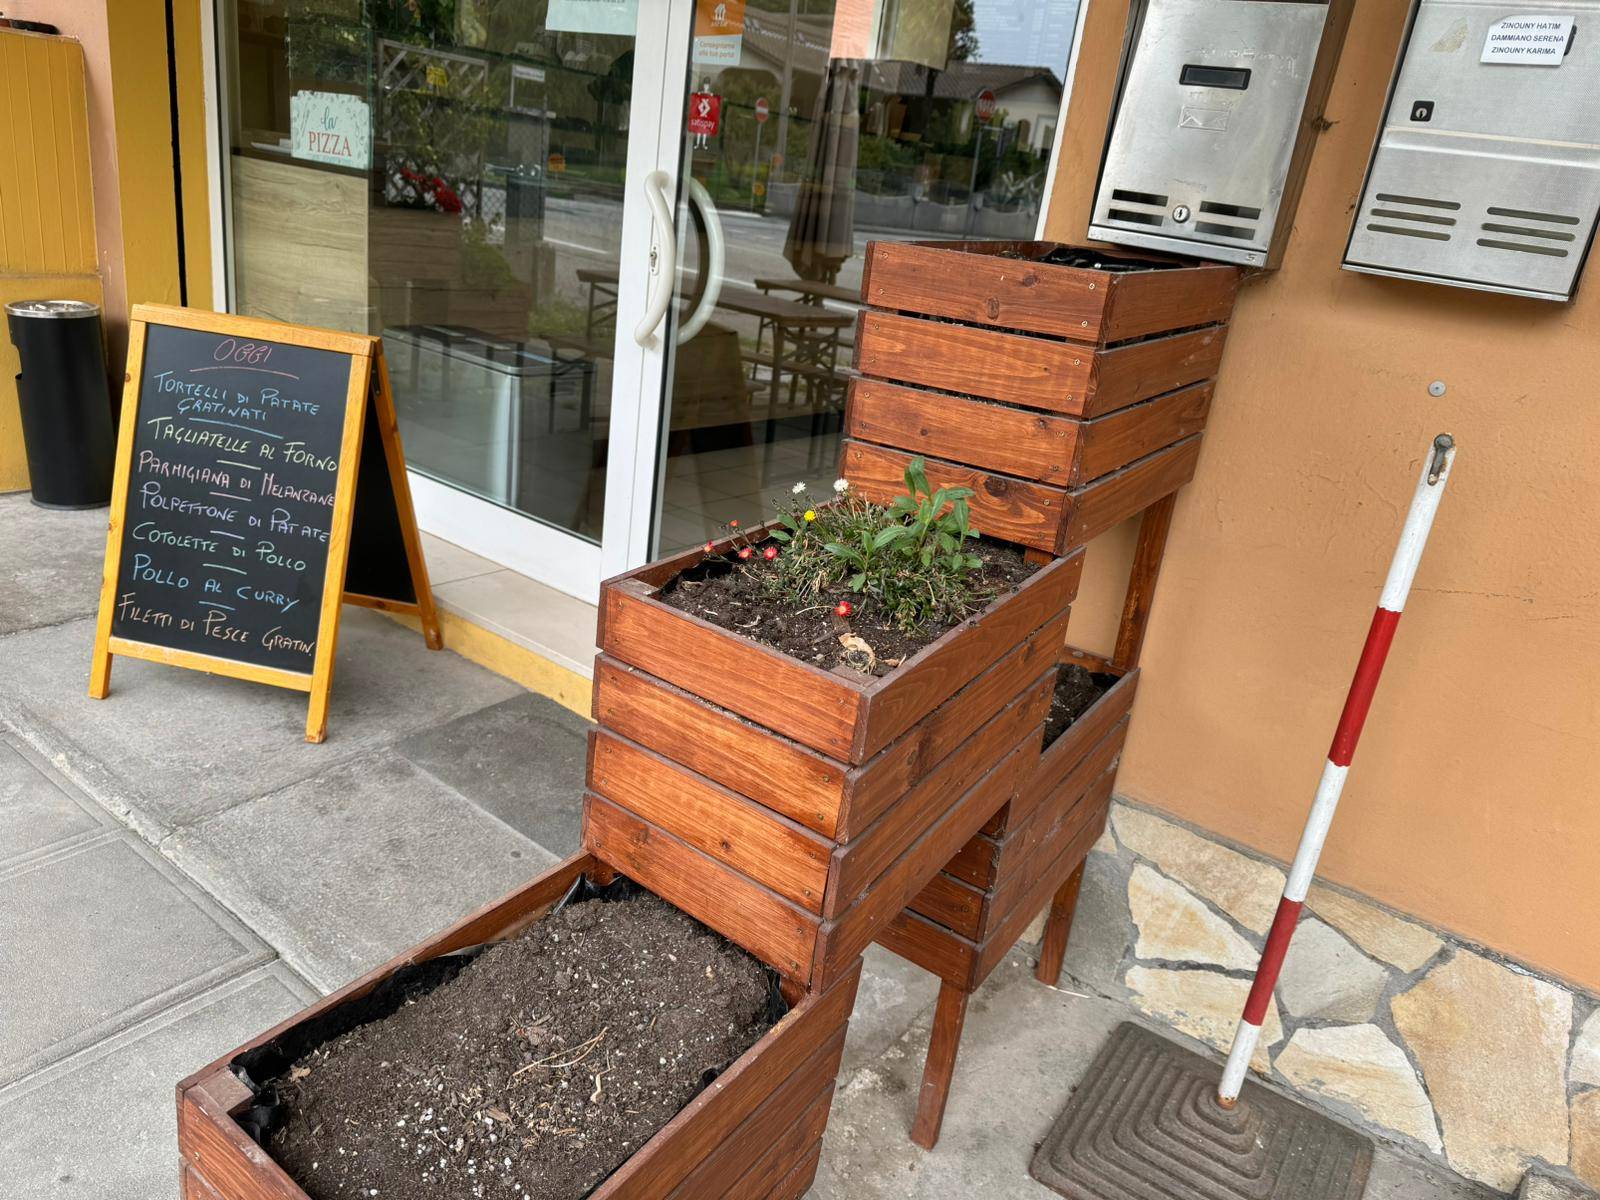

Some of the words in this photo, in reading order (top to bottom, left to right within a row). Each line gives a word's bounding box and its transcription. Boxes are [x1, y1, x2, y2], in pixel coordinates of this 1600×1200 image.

[1526, 47, 1556, 55] KARIMA
[1533, 34, 1564, 42] SERENA
[308, 131, 352, 157] PIZZA
[213, 338, 272, 364] OGGI
[153, 370, 227, 400] TORTELLI
[236, 392, 250, 404] DI
[261, 388, 320, 415] PATATE
[177, 397, 267, 421] GRATINATI
[148, 416, 251, 453] TAGLIATELLE
[259, 443, 275, 460] AL
[283, 441, 338, 472] FORNO
[138, 450, 230, 489] PARMIGIANA
[240, 478, 252, 489] DI
[261, 475, 336, 506] MELANZANE
[140, 481, 238, 522] POLPETTONE
[248, 515, 261, 527] DI
[133, 522, 219, 553] COTOLETTE
[232, 546, 245, 557] DI
[256, 541, 306, 571] POLLO
[133, 553, 190, 589] POLLO
[204, 579, 222, 593] AL
[236, 586, 300, 613] CURRY
[118, 592, 173, 623] FILETTI
[180, 619, 194, 631] DI
[203, 610, 250, 643] PESCE
